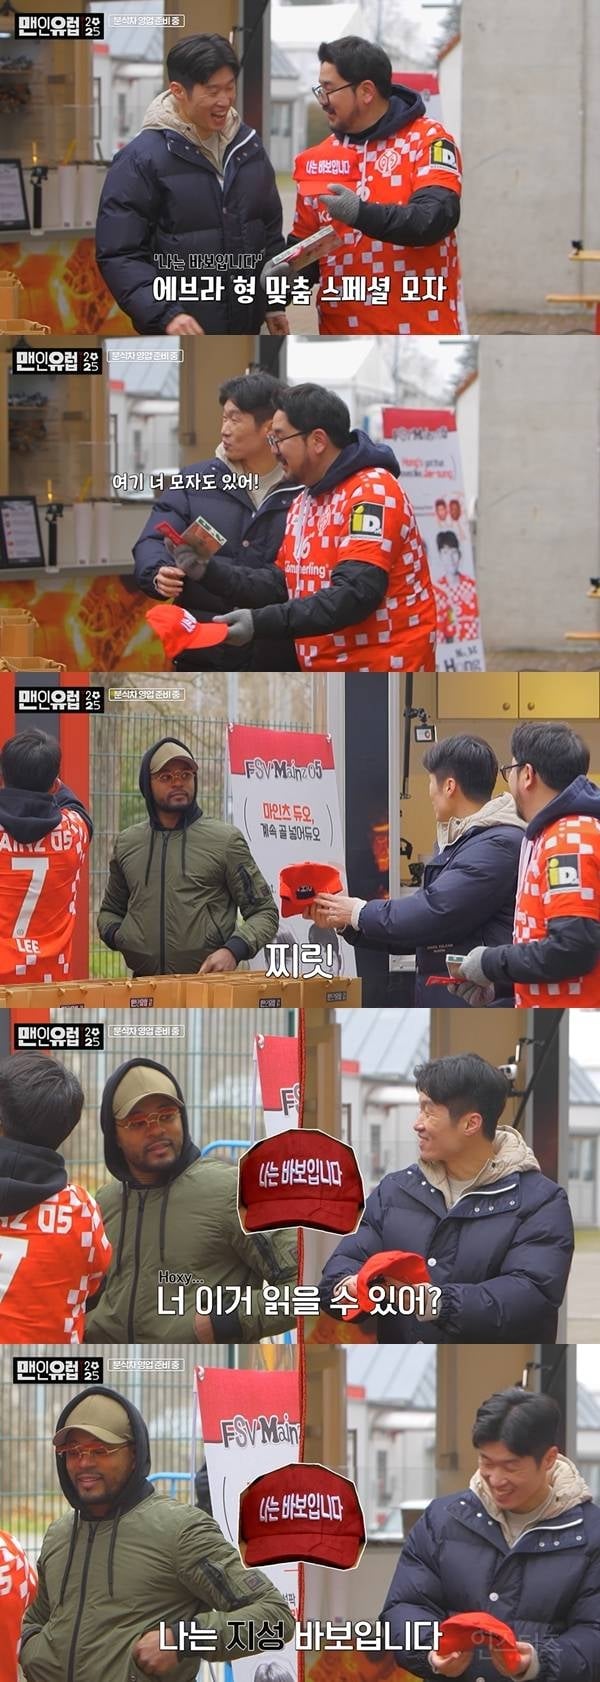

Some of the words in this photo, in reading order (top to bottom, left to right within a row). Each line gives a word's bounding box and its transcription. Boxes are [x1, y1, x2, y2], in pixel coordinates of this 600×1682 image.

[306, 160, 318, 175] 나는
[318, 159, 350, 175] 바보입니다
[263, 802, 292, 821] 마인츠
[293, 805, 315, 825] 듀오,
[51, 830, 73, 851] 05
[260, 823, 277, 839] 계속
[278, 824, 288, 840] 골
[11, 857, 49, 939] 7
[16, 938, 41, 954] LEE
[259, 1161, 280, 1189] 나는
[281, 1158, 343, 1188] 바보입니다
[38, 1204, 73, 1234] 05
[222, 1416, 257, 1448] FSV
[259, 1414, 299, 1445] Main
[259, 1494, 280, 1523] 나는
[281, 1492, 344, 1522] 바보입니다
